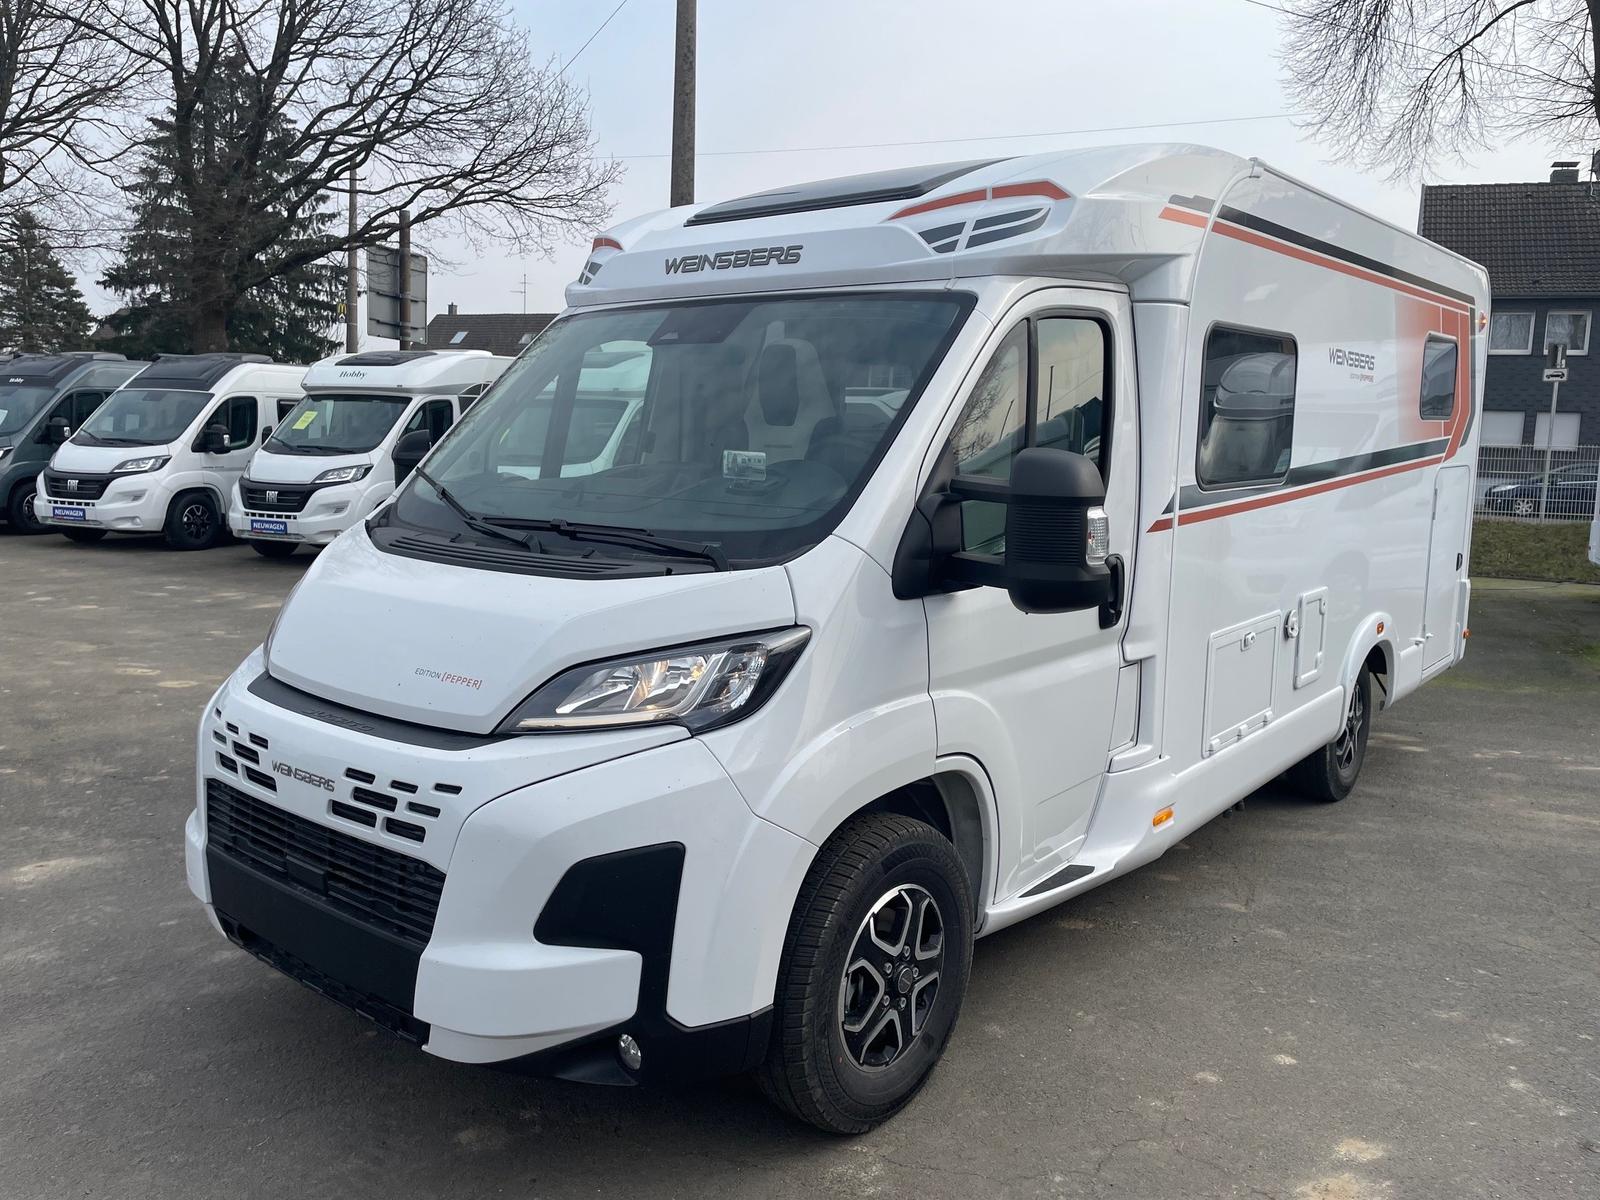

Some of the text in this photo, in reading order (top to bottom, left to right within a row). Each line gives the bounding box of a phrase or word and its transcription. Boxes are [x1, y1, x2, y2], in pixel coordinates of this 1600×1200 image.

[665, 245, 803, 275] WEINSBERG
[1329, 347, 1375, 370] WEINSBERG
[339, 371, 367, 379] Hobby
[54, 508, 84, 516] NEUWAGEN
[253, 522, 285, 530] NEUWAGEN
[414, 667, 441, 679] EDITION
[272, 759, 335, 792] WEINSBERG
